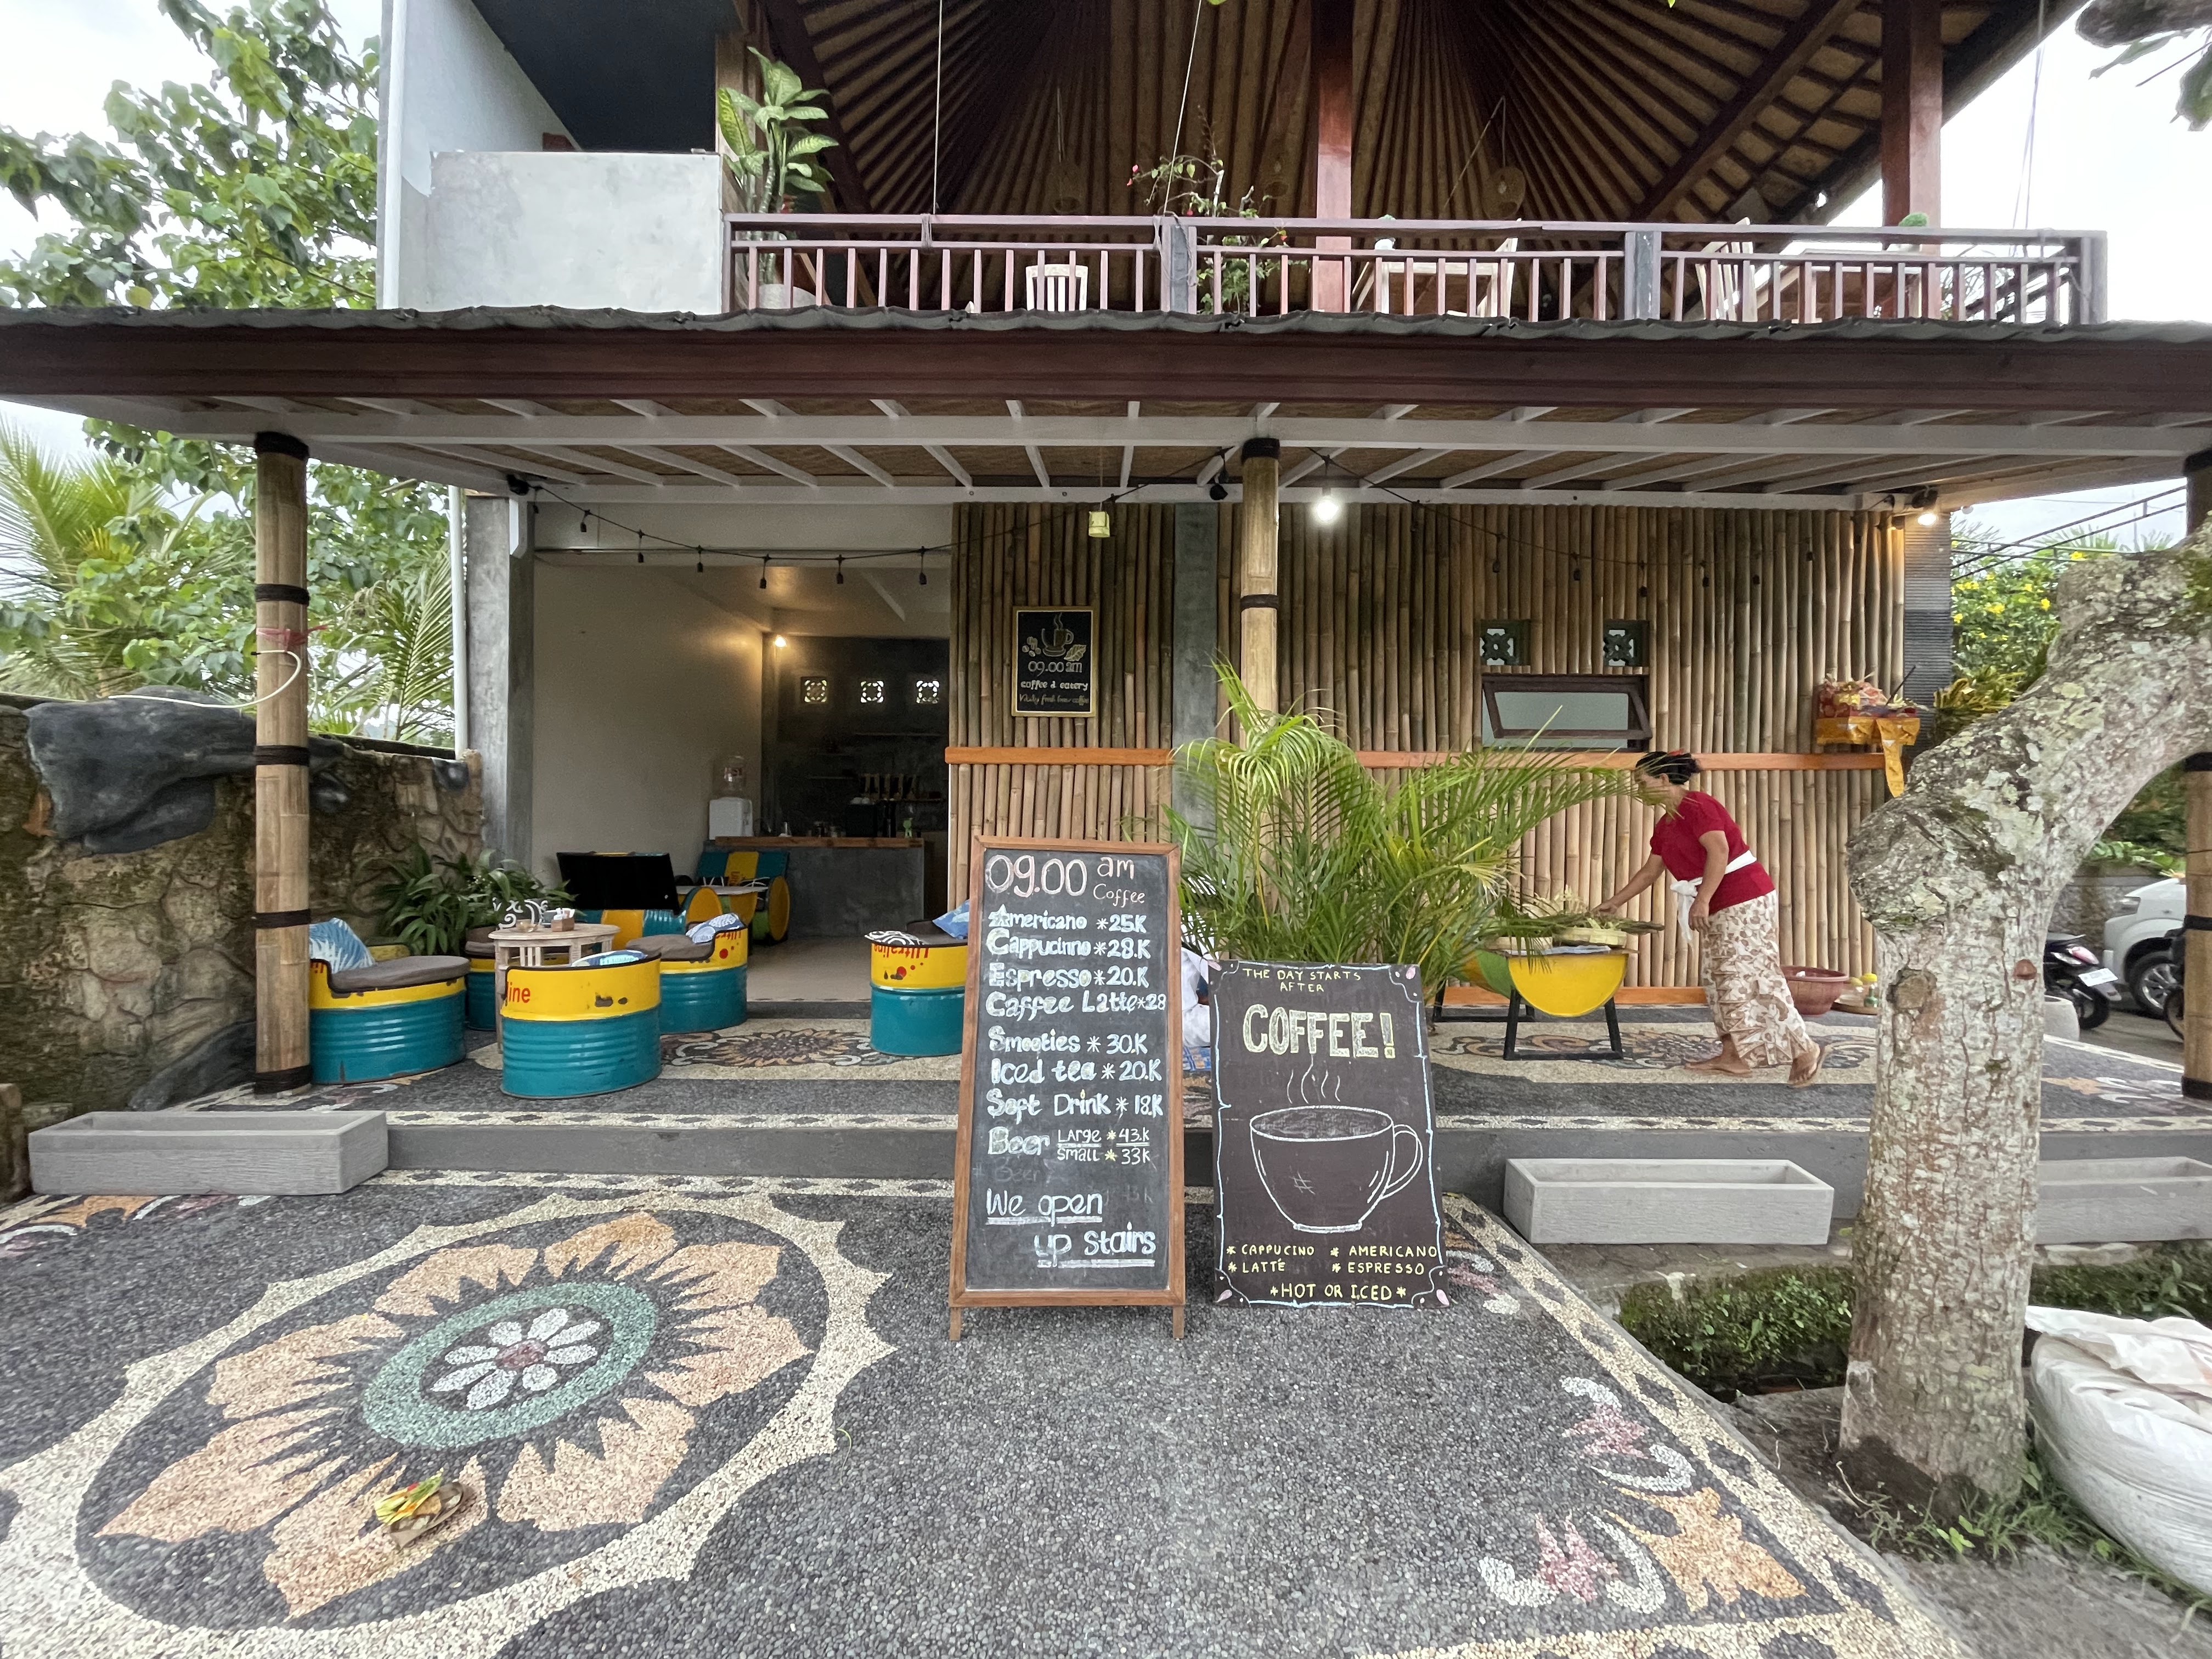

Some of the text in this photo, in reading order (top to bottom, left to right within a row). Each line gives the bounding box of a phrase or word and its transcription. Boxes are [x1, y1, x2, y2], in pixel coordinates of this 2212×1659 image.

[1028, 661, 1064, 676] 09.00
[1020, 680, 1048, 690] coffee
[1059, 682, 1088, 691] eatery
[985, 854, 1135, 898] 09.00 am
[1093, 883, 1145, 907] Coffee
[988, 904, 1087, 930] Americano
[989, 962, 1092, 992] Espresso
[1242, 968, 1362, 981] THE DAY STARTS
[1280, 982, 1325, 992] AFTER
[1082, 990, 1138, 1014] Latte
[988, 1025, 1081, 1053] Smooties
[1243, 1003, 1395, 1059] COFFEE!
[991, 1058, 1045, 1085] Iced
[1051, 1060, 1097, 1082] tea
[986, 1088, 1042, 1125] Soft
[988, 1126, 1050, 1155] Beer
[986, 1188, 1026, 1216] We
[1038, 1193, 1103, 1227] open
[1242, 1244, 1314, 1256] CAPPUCINO
[1348, 1245, 1437, 1258] AMERICANO
[1347, 1262, 1425, 1275] ESPRESSO
[1281, 1283, 1392, 1301] HOT OR ICED
